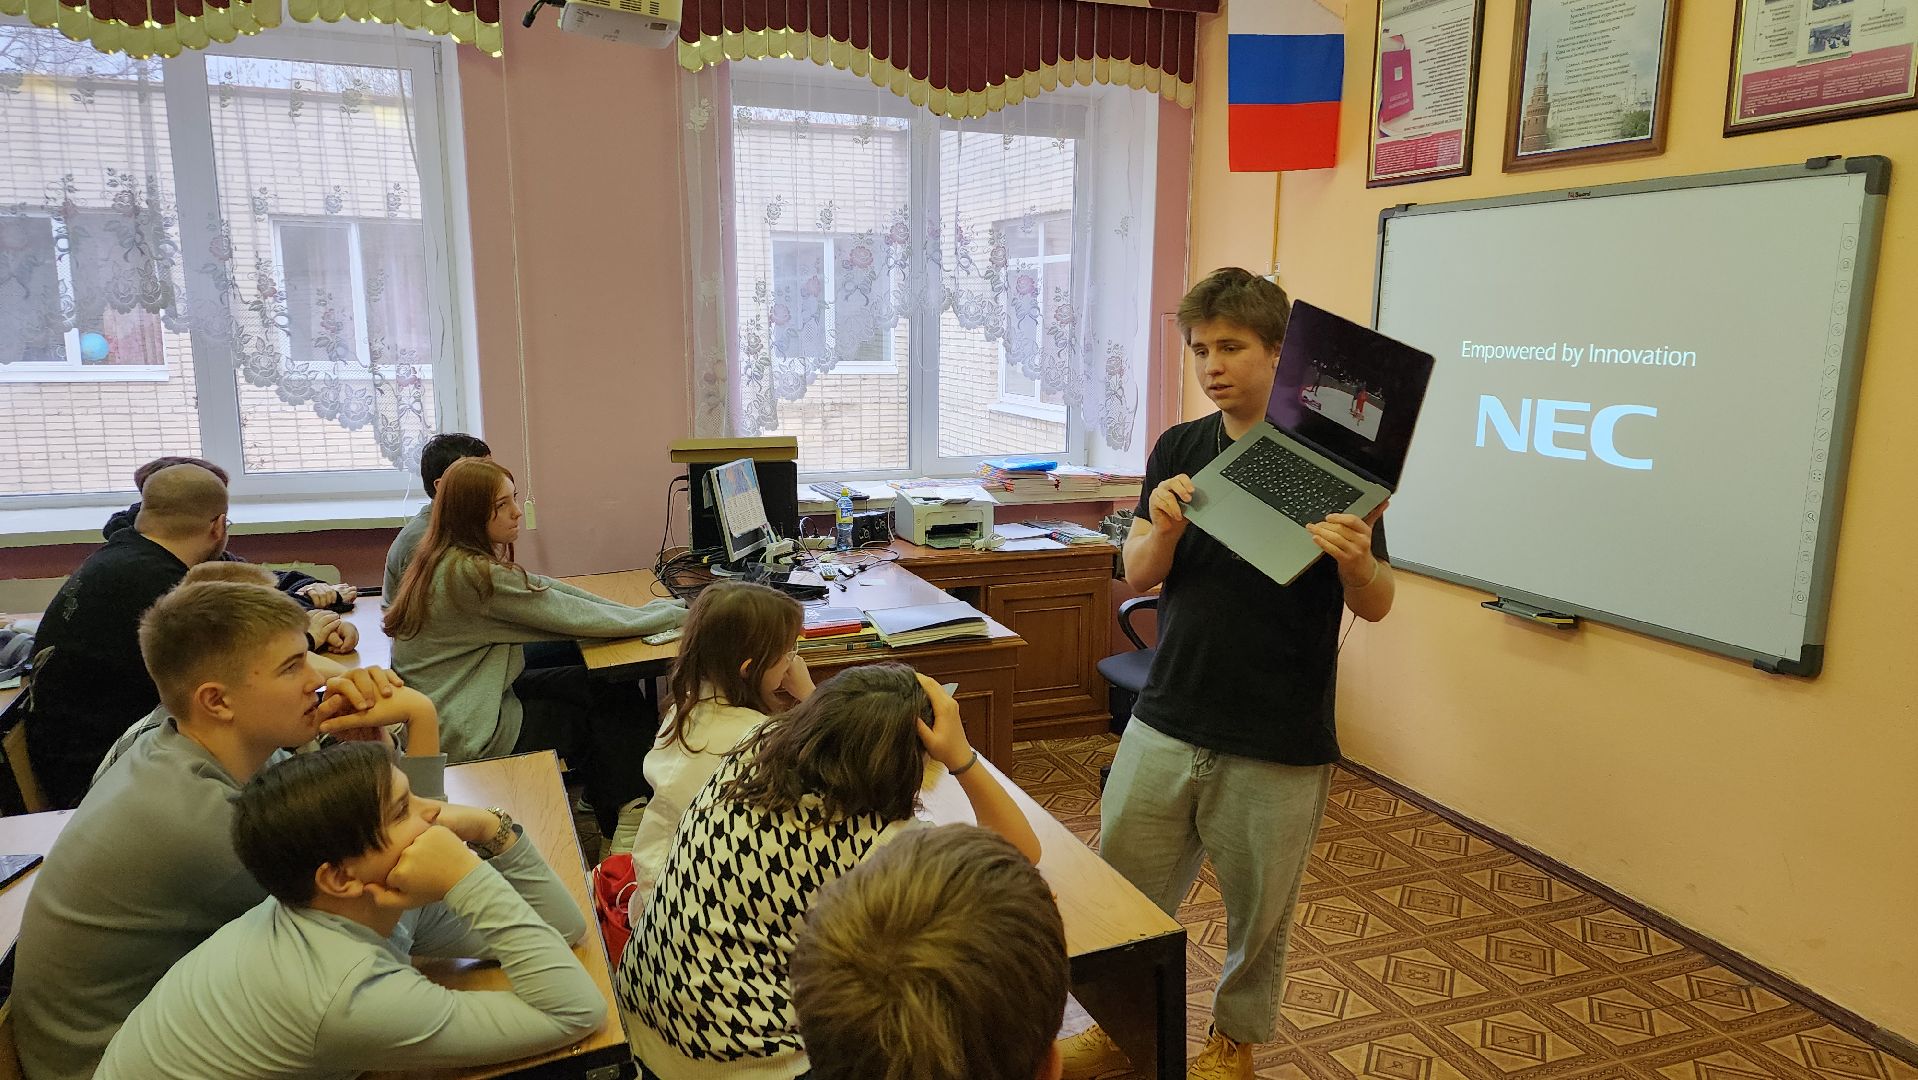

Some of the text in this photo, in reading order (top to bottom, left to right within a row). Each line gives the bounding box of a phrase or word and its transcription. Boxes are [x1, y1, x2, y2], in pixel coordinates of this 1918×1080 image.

[1461, 340, 1697, 367] Empowered by Innovation
[1475, 394, 1658, 470] NEC
